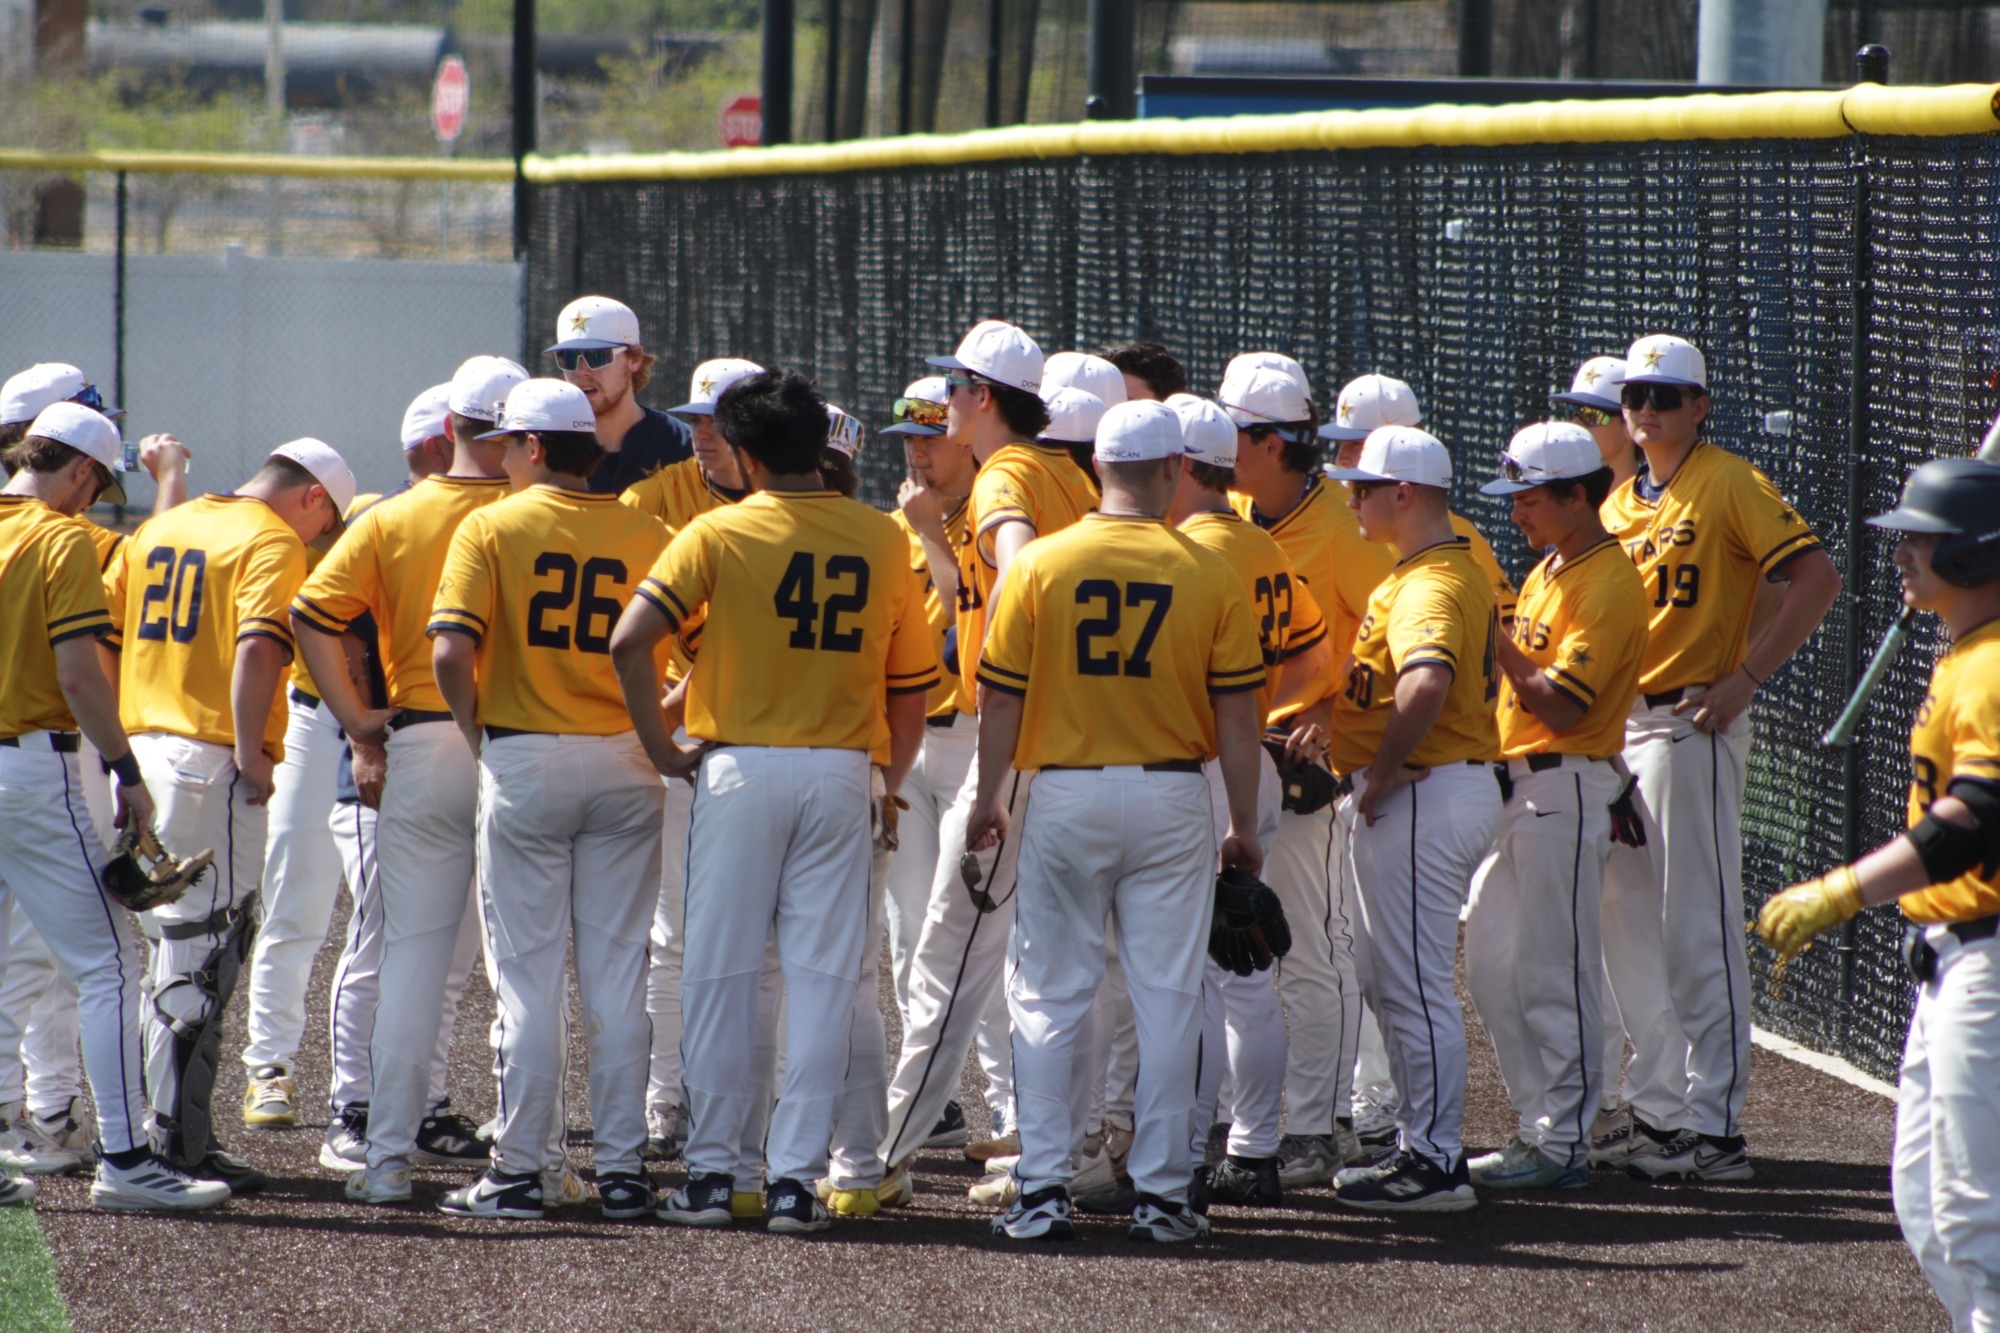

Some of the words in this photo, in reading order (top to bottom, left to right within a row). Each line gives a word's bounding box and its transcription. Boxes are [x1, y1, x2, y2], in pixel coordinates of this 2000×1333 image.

[726, 113, 762, 141] STO
[137, 546, 206, 645] 20
[527, 552, 628, 655] 26
[774, 551, 870, 653] 42
[1075, 579, 1173, 678] 27
[1653, 563, 1700, 608] 19
